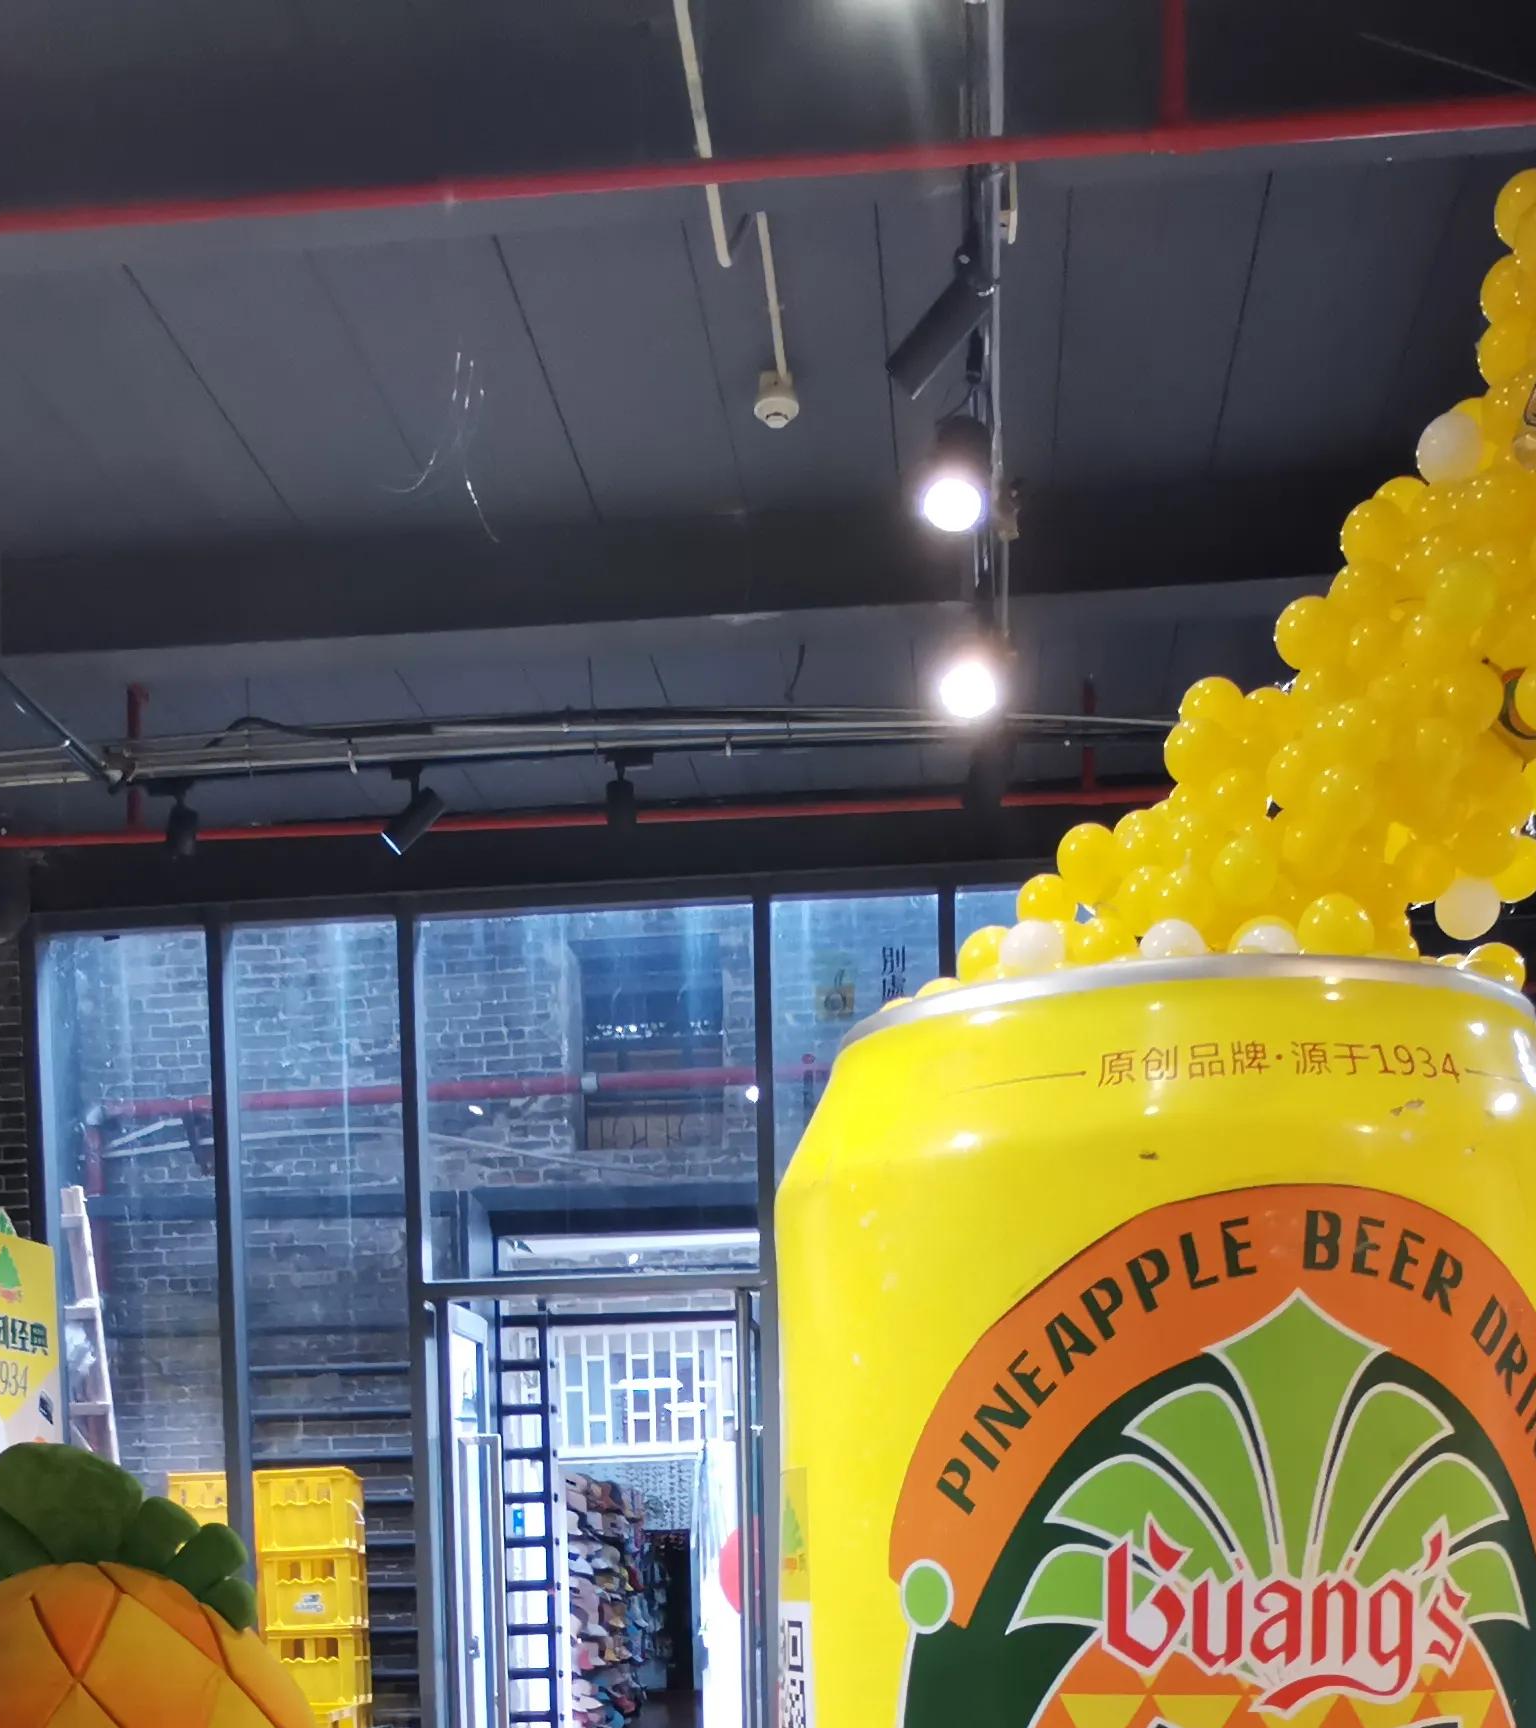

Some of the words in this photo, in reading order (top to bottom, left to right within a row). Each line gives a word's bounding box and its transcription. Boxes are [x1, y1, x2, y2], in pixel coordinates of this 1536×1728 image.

[935, 1215, 1259, 1516] PINEAPPLE
[1302, 1208, 1465, 1316] BEER
[1105, 1523, 1469, 1711] Guang's
